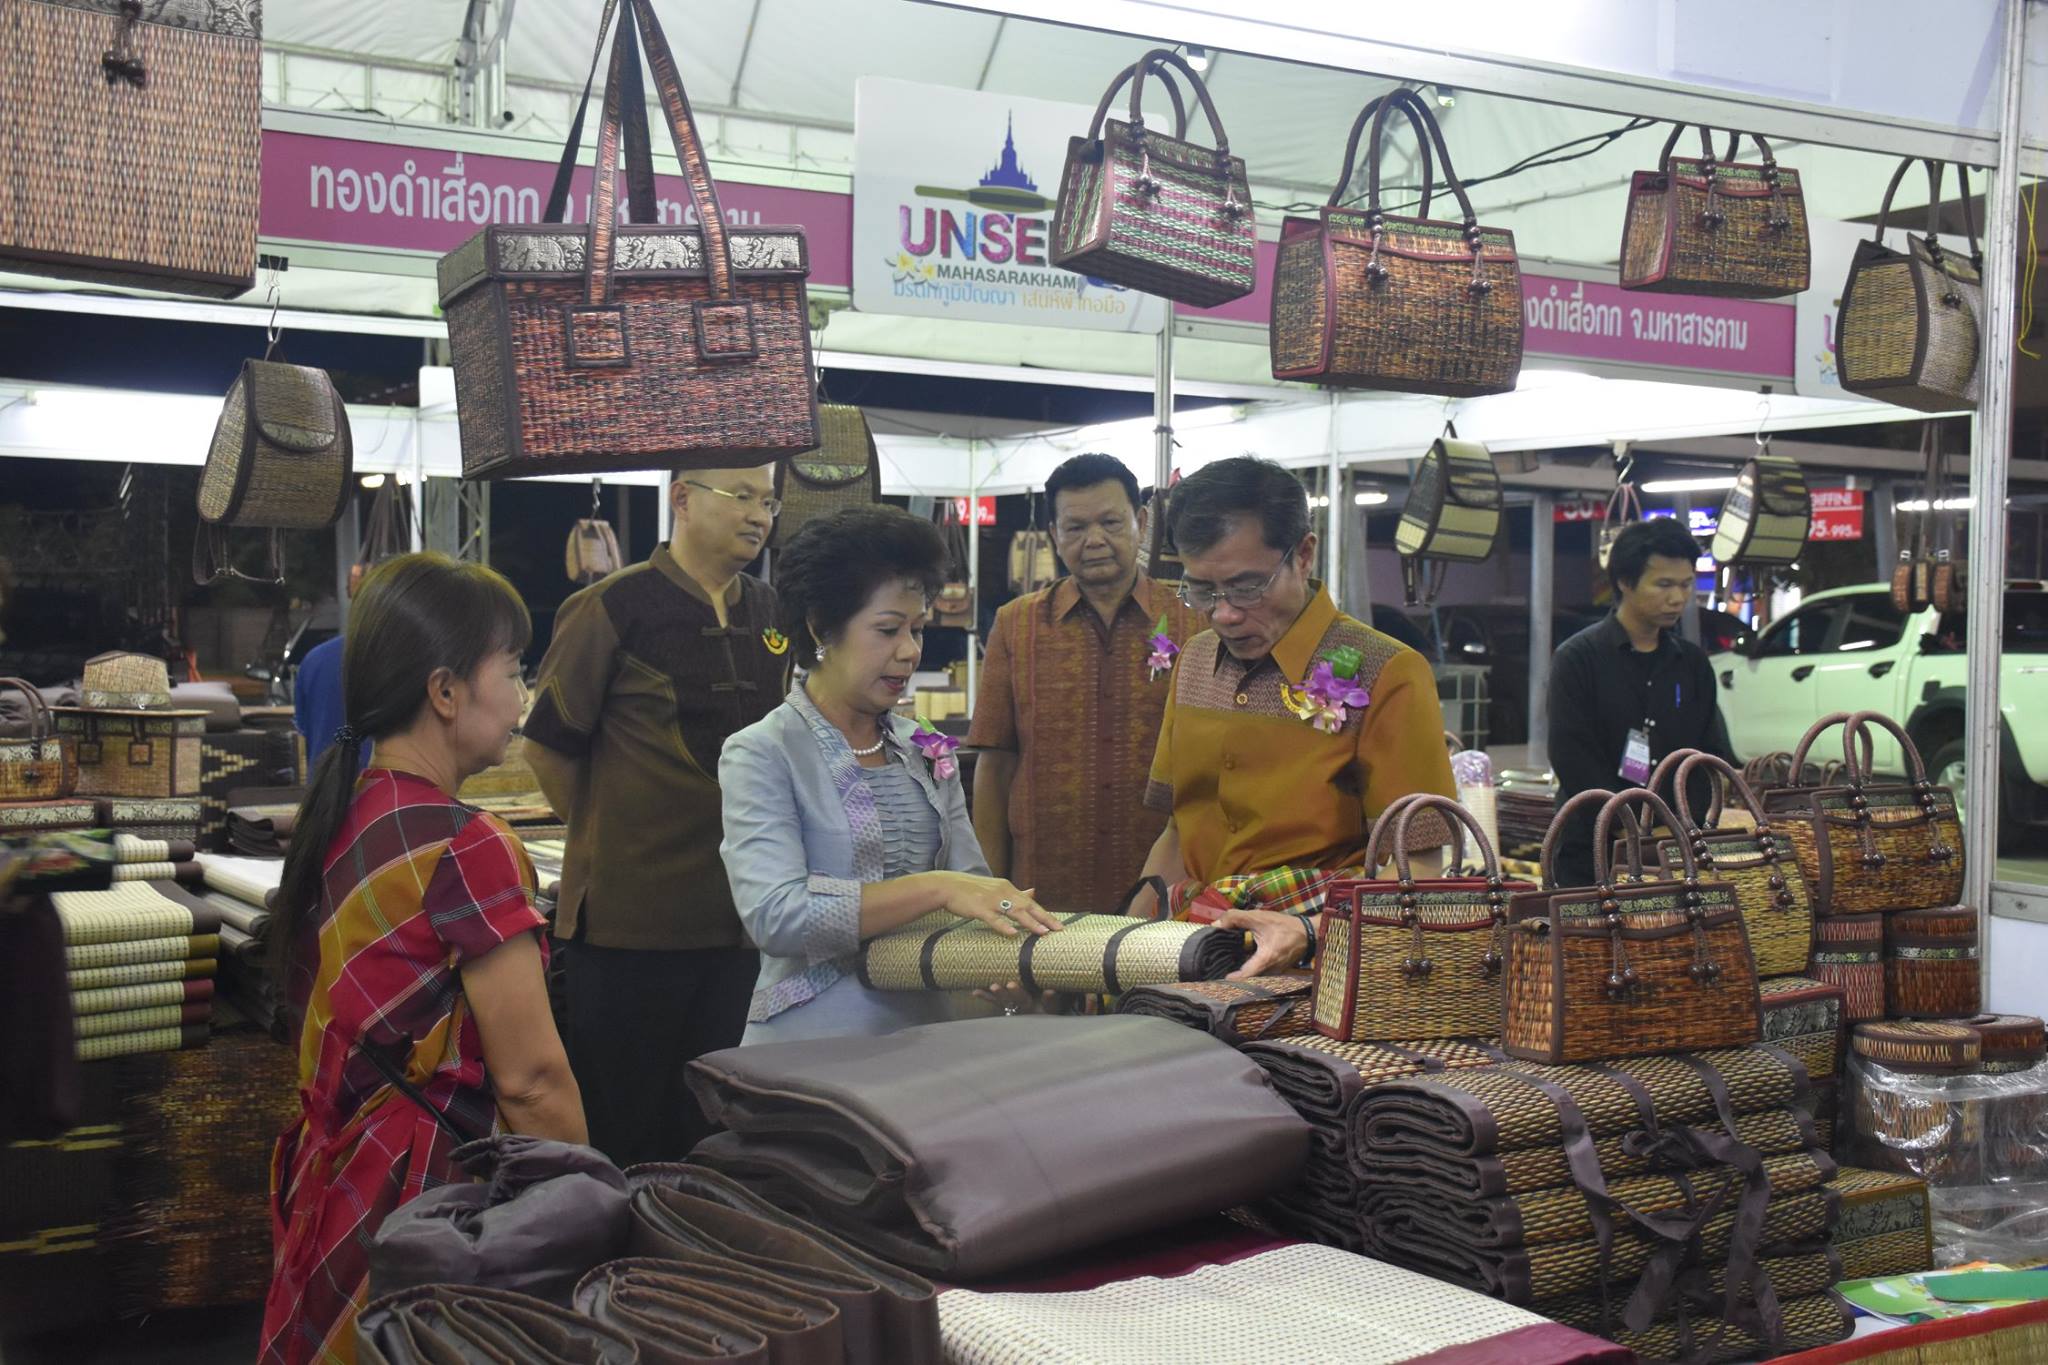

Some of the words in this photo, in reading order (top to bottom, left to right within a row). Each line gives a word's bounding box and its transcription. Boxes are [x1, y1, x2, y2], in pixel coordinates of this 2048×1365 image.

[310, 152, 541, 225] ทองดำเสื่อกก
[900, 204, 1055, 269] UNSE
[937, 264, 1077, 289] MAHASARAKHAM
[1524, 281, 1622, 337] งดำเสื่อกก
[1630, 308, 1748, 350] จ.มหาสารคาม
